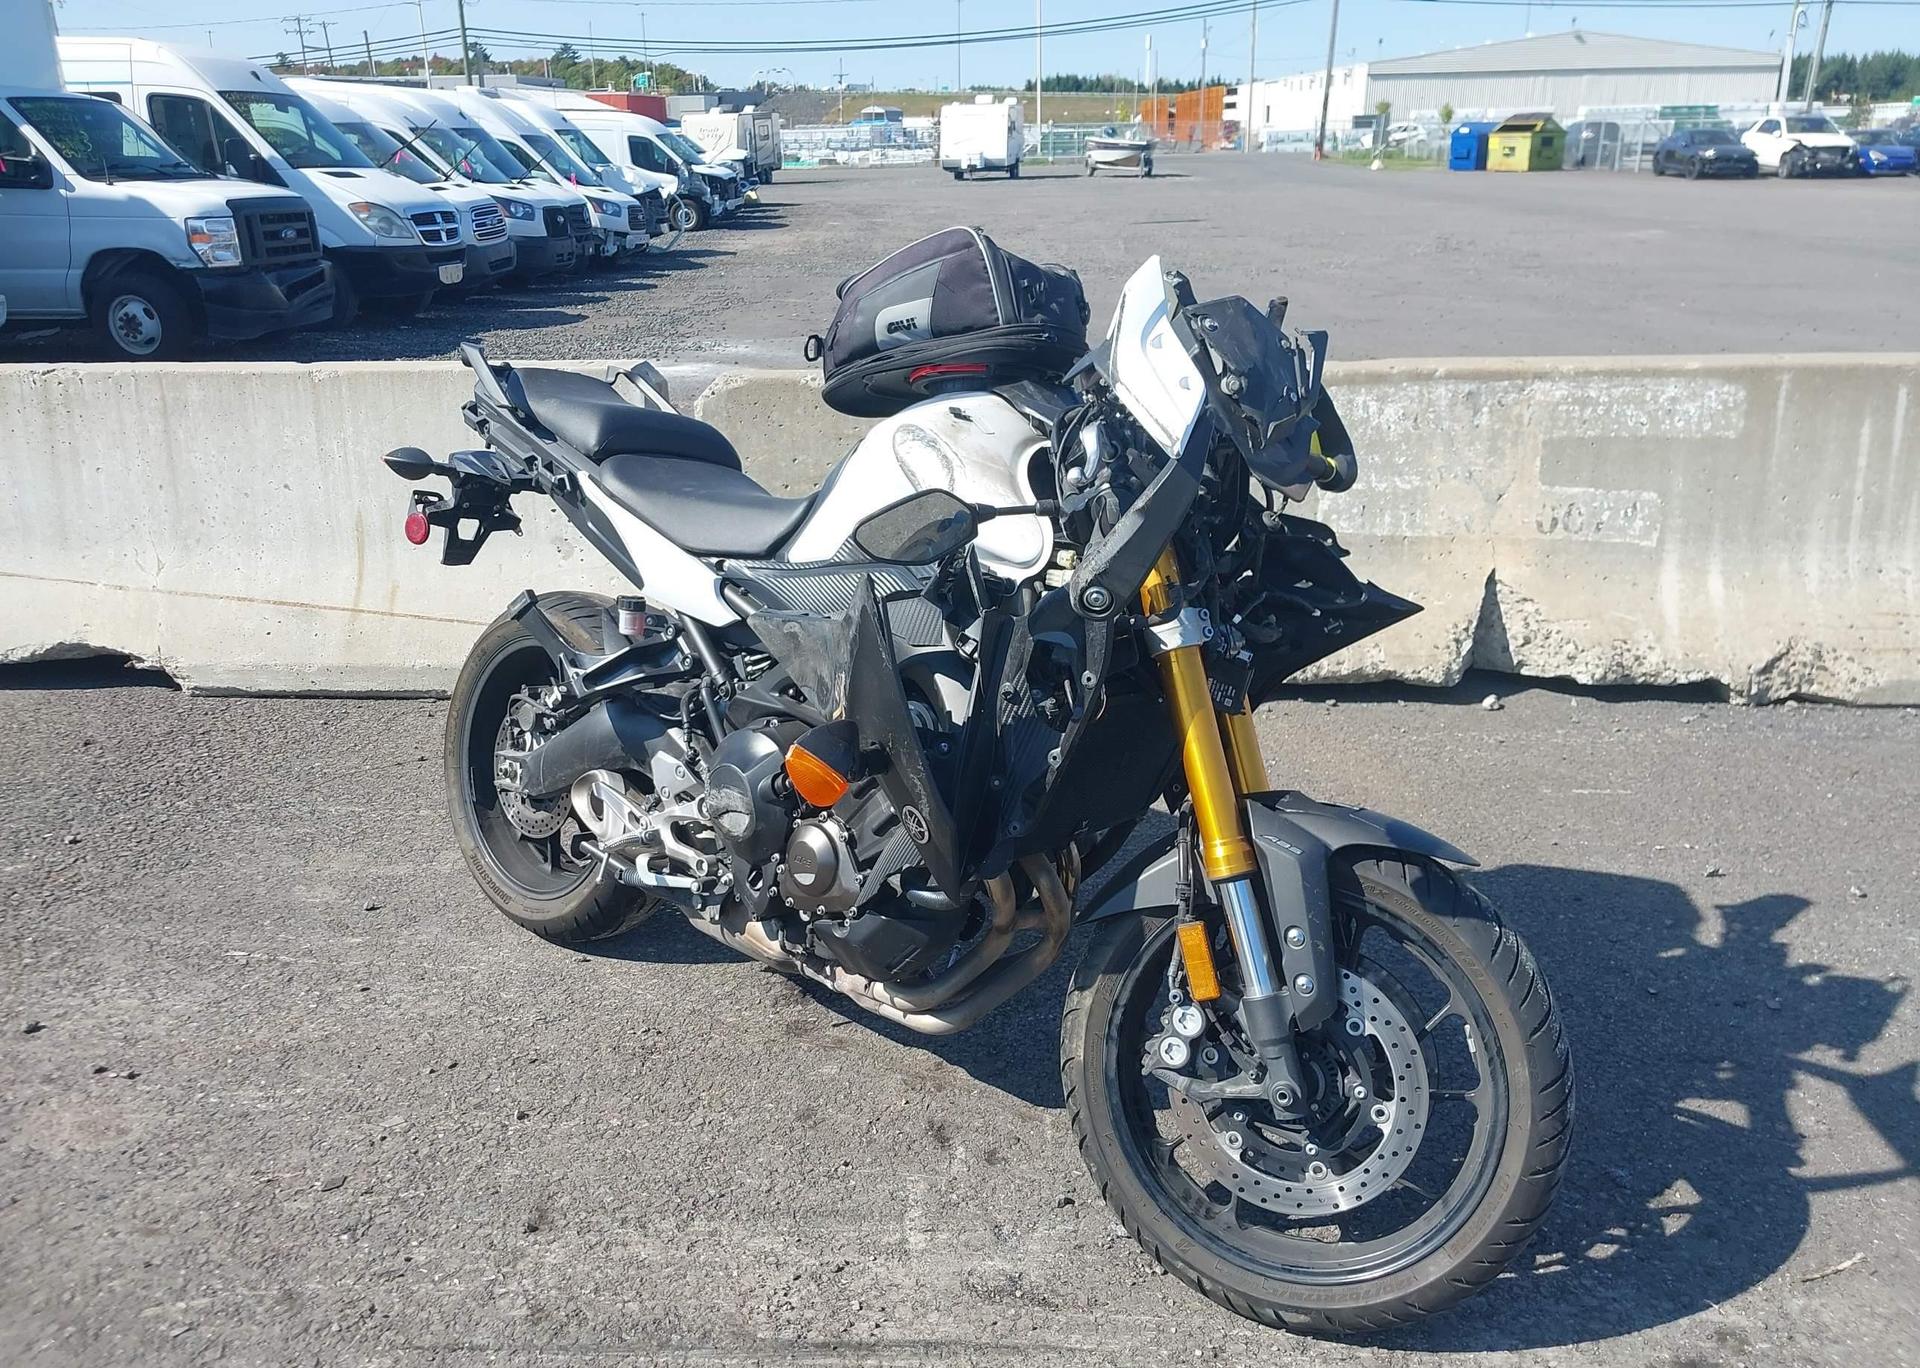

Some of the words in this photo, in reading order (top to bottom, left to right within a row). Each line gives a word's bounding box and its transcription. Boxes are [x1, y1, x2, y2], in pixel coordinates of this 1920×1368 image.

[886, 316, 918, 335] GIVI
[1262, 835, 1304, 855] ABS
[470, 853, 514, 905] BRIDGESTONE
